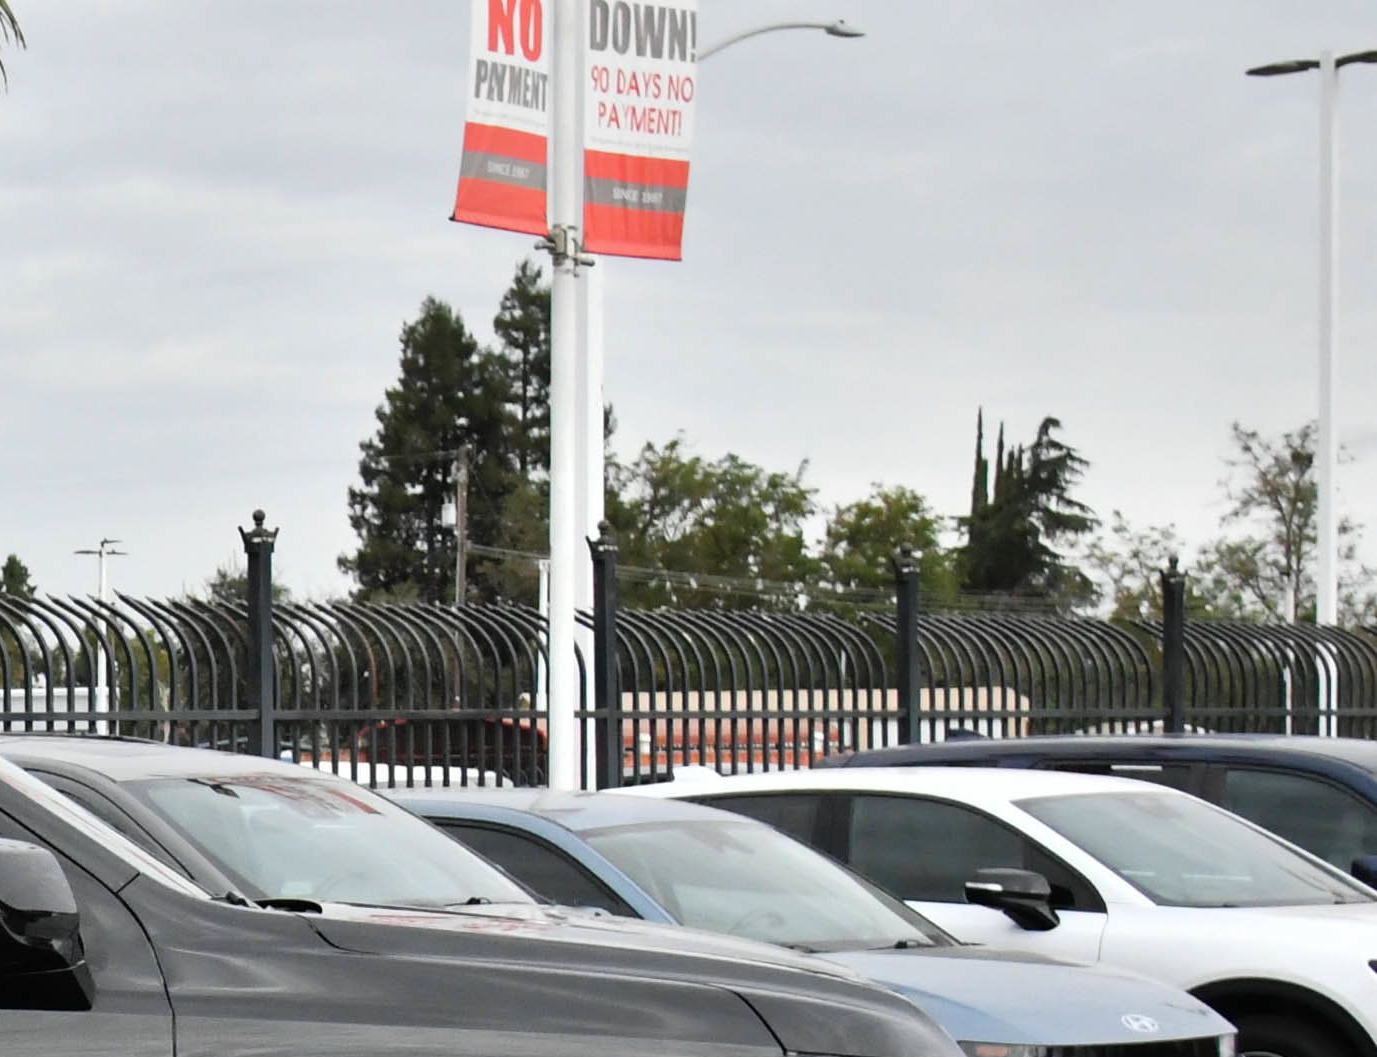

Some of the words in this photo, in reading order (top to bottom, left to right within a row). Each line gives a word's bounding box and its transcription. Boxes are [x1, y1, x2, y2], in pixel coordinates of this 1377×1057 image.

[488, 0, 543, 62] NO
[589, 0, 697, 63] DOWN!
[475, 59, 549, 112] PAYMENT
[590, 65, 608, 94] 90
[616, 69, 662, 100] DAYS
[667, 74, 694, 104] NO
[597, 101, 683, 137] PAYMENT!
